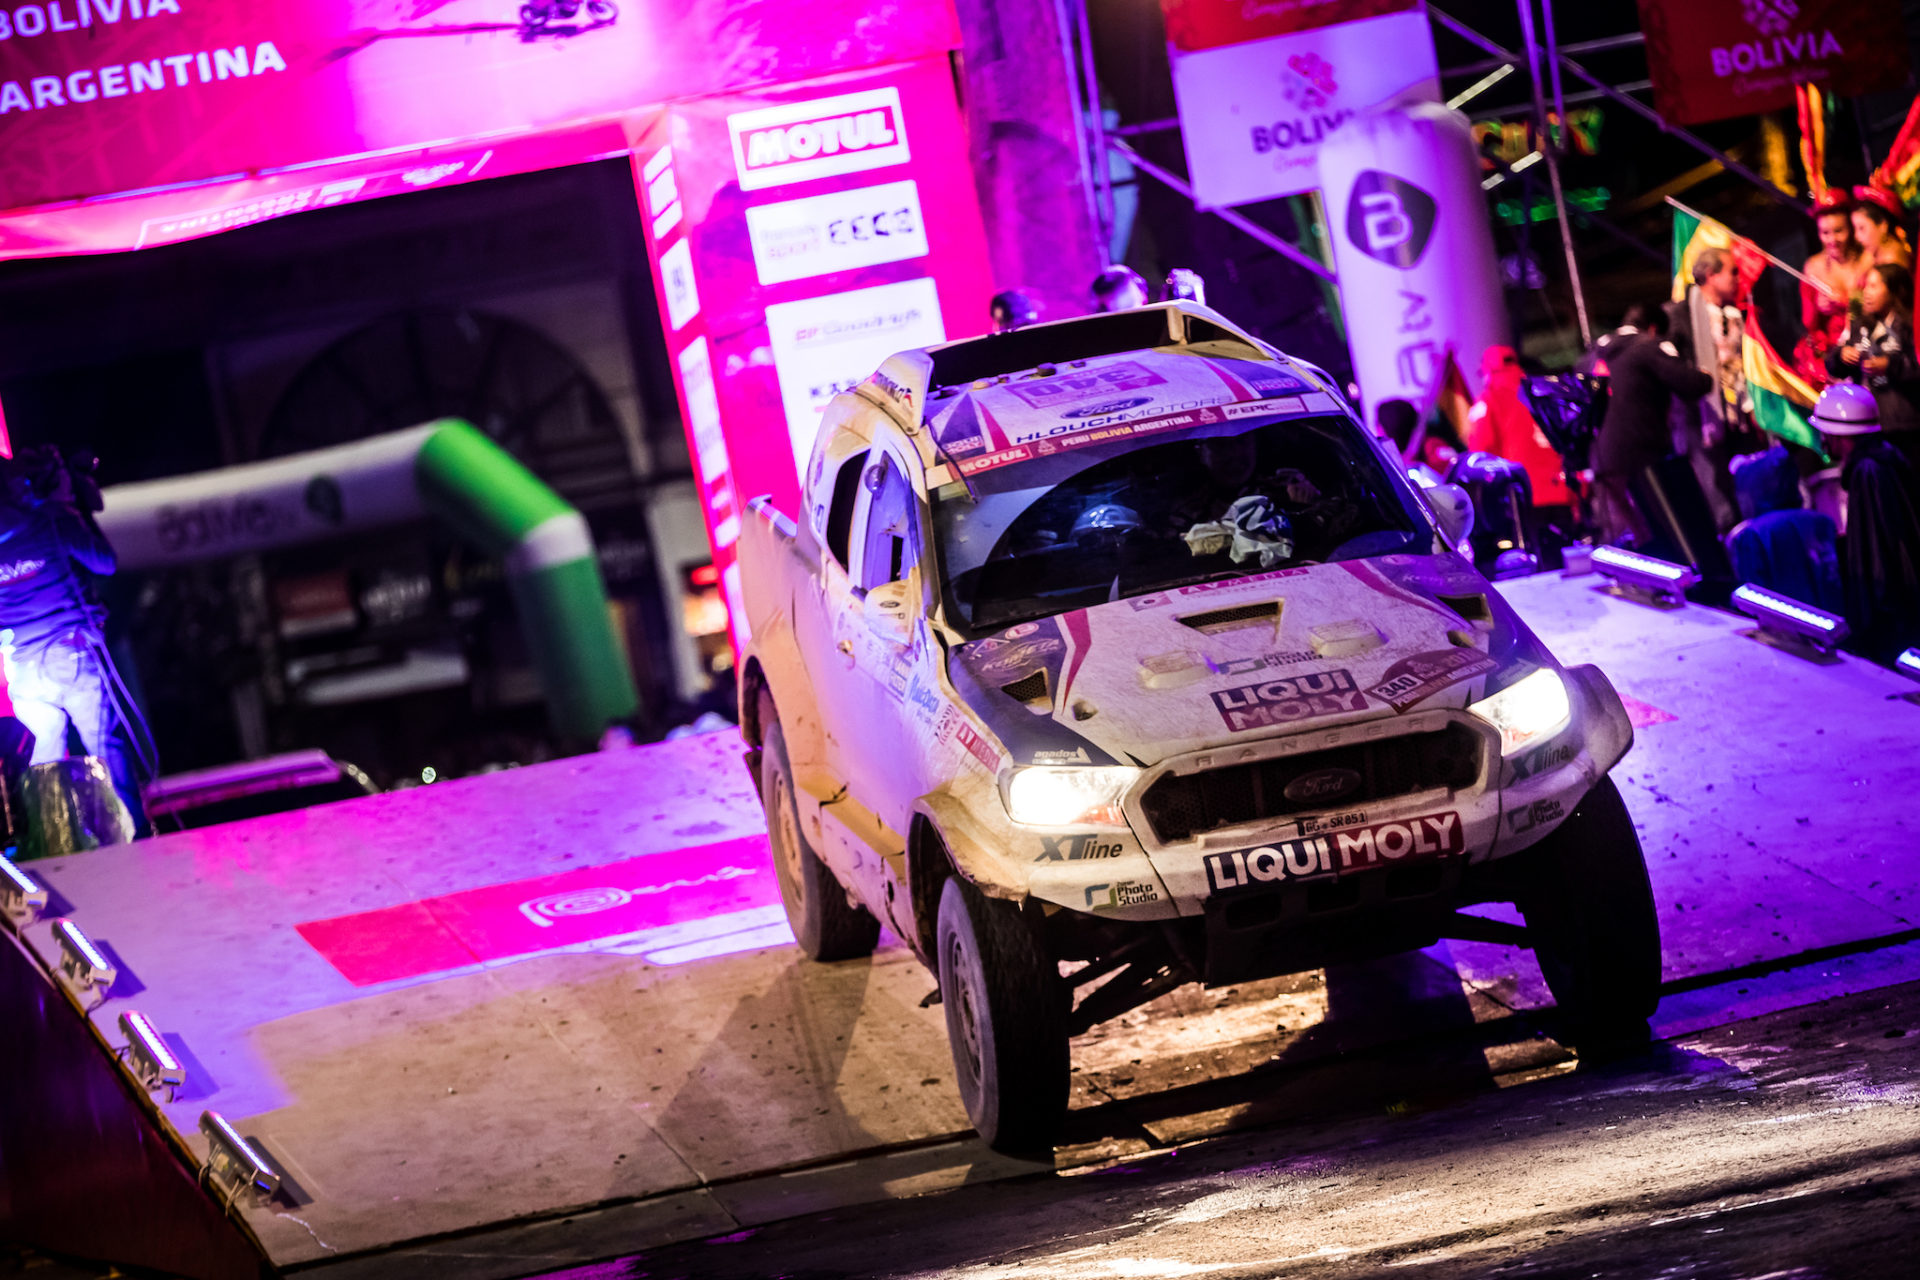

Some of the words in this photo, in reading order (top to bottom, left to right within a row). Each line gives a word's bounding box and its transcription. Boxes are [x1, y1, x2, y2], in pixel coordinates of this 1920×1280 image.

[1711, 29, 1843, 77] BOLIVIA
[0, 41, 286, 114] ARGENTINA
[748, 111, 894, 166] MOTUL
[1251, 109, 1354, 153] BOLIV
[1062, 434, 1090, 447] PERU
[1090, 426, 1133, 441] BOLIVIA
[1134, 415, 1193, 432] ARGENTINA
[958, 449, 1027, 474] MOTUL
[1218, 671, 1350, 709] LIQUI
[1377, 676, 1417, 697] 340
[1229, 691, 1356, 730] MOLY
[1034, 749, 1077, 760] agados
[1195, 718, 1426, 768] RANGER
[1034, 833, 1123, 862] XTline
[1210, 837, 1333, 889] LIQUI
[1336, 814, 1456, 867] MOLY
[1117, 883, 1153, 896] Photo
[1119, 892, 1158, 905] Studio
